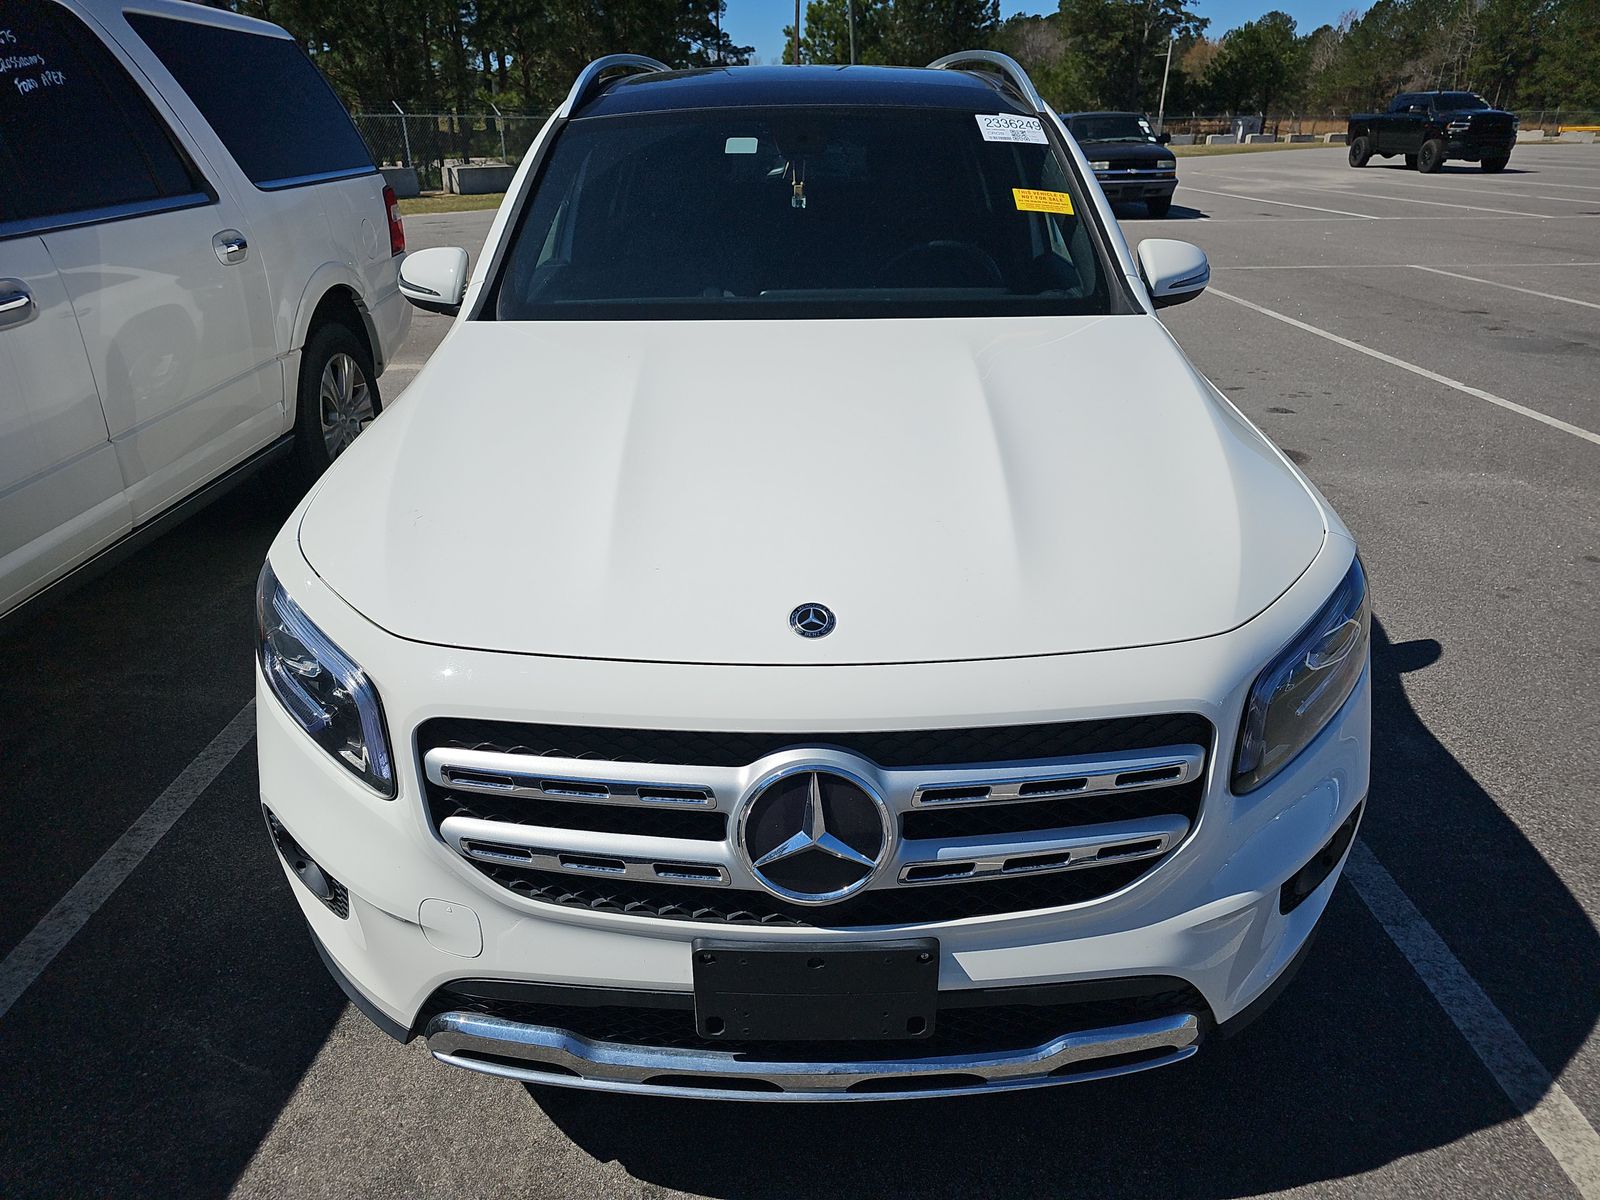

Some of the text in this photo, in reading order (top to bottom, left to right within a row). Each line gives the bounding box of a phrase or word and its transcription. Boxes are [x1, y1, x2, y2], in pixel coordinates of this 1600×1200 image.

[0, 54, 45, 72] ROSSROADS
[41, 71, 67, 86] APEX
[984, 117, 1042, 131] 2336249
